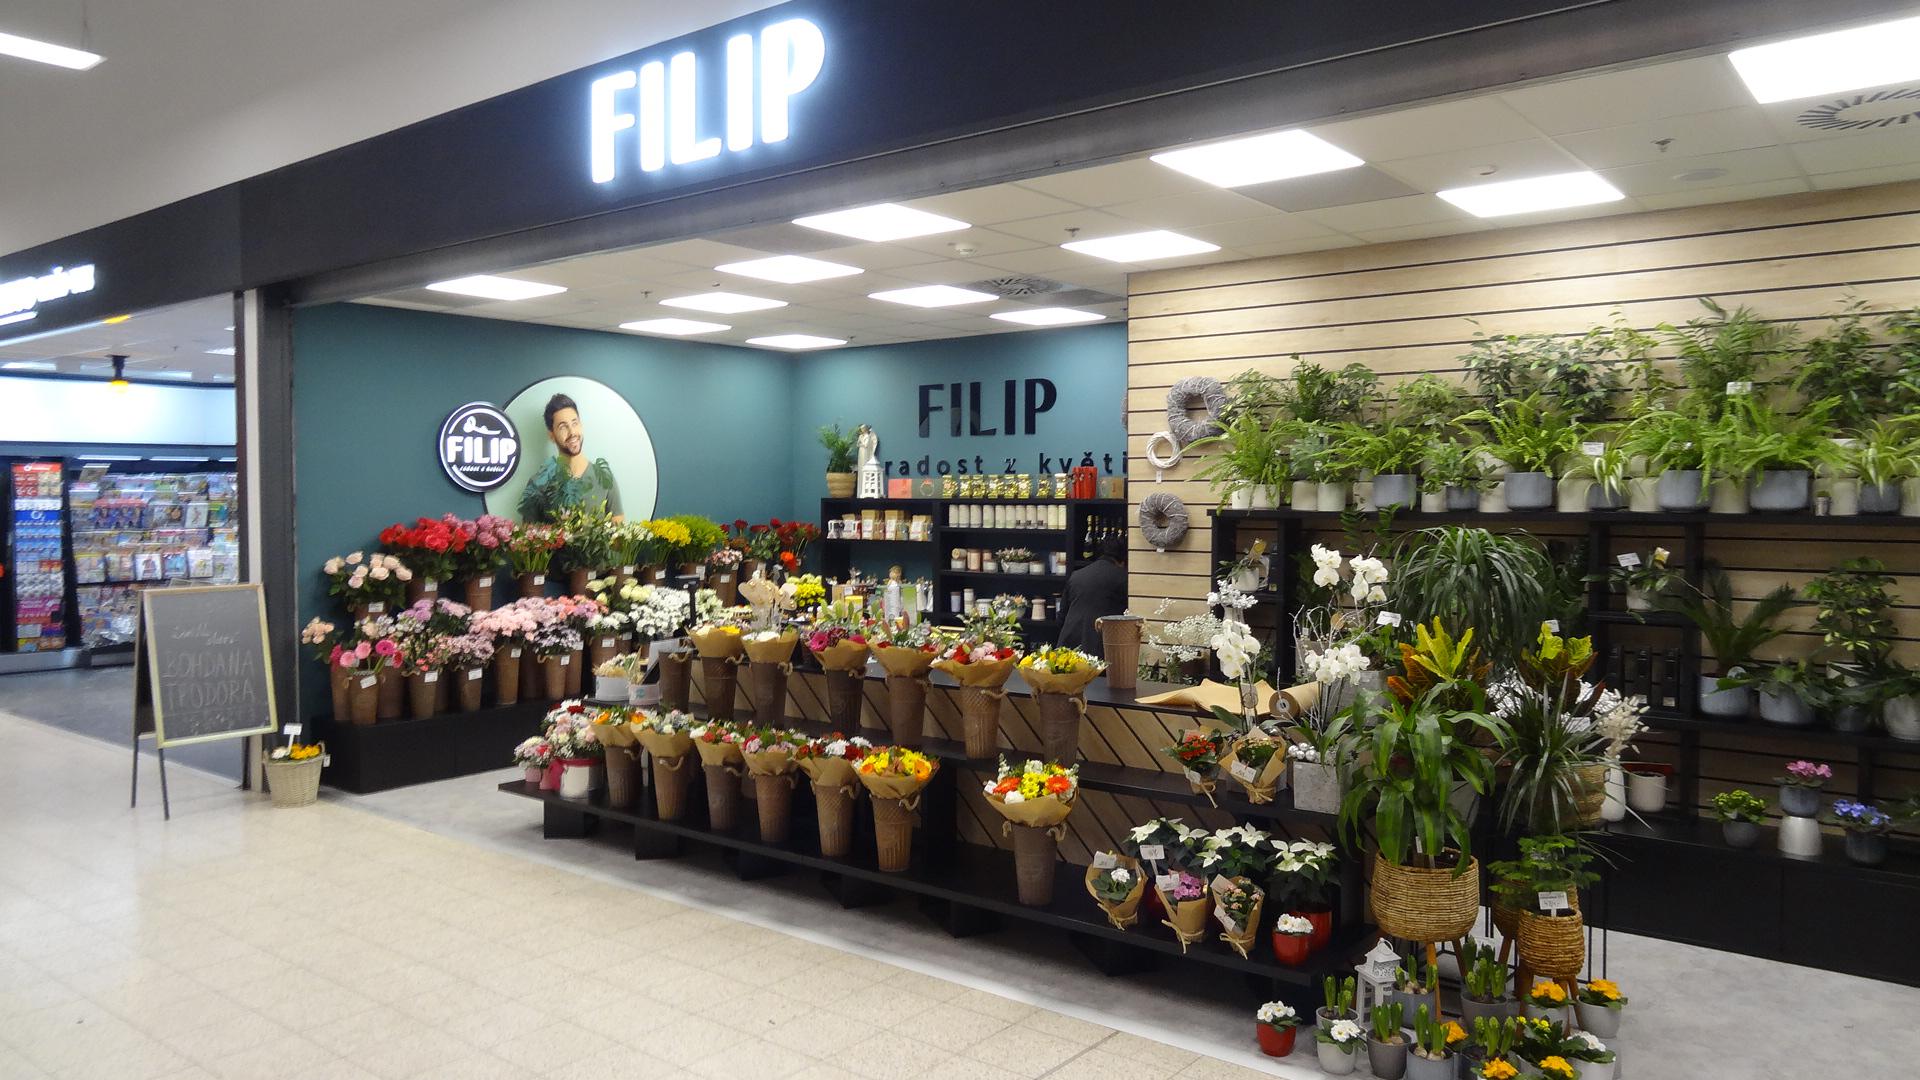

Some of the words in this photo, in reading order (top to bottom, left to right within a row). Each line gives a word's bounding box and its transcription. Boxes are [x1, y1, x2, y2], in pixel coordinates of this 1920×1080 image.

[591, 17, 826, 184] FILIP
[918, 377, 1058, 438] FILIP
[447, 435, 517, 465] FILIP
[884, 454, 984, 476] radost
[1004, 457, 1017, 475] z
